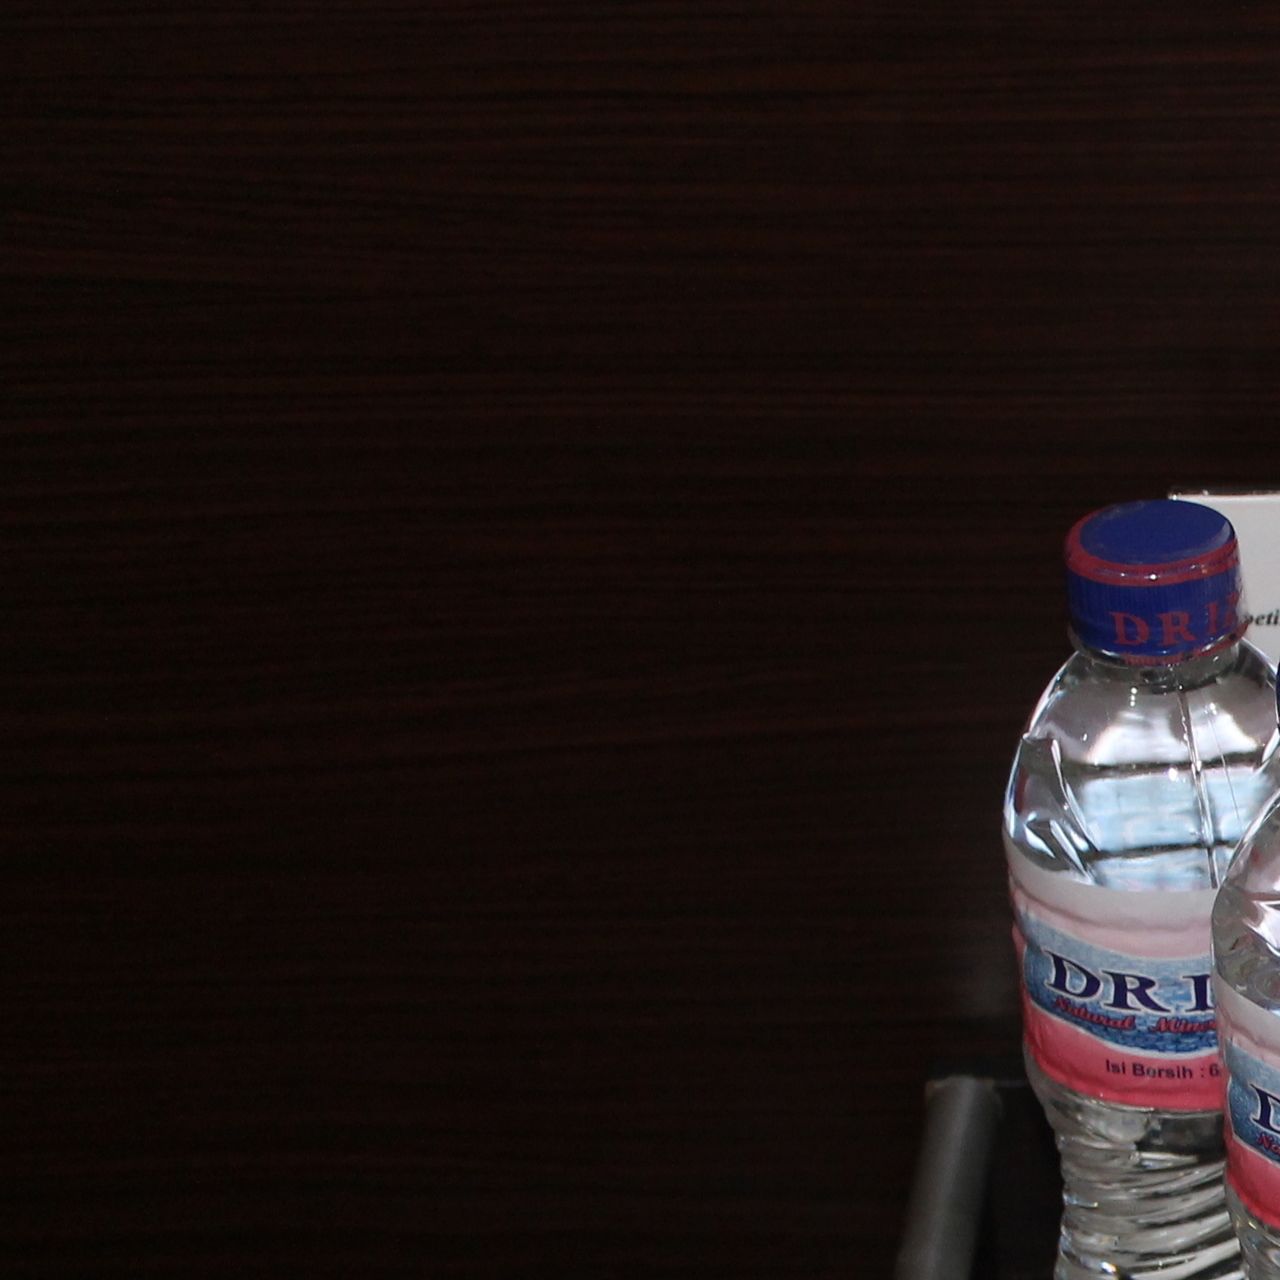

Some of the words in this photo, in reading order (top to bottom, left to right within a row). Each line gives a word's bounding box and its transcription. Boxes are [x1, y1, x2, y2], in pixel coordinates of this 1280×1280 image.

[1045, 949, 1215, 1012] DRI
[1054, 996, 1136, 1031] Natural
[1105, 1059, 1126, 1075] Isi
[1132, 1063, 1193, 1079] Bersih
